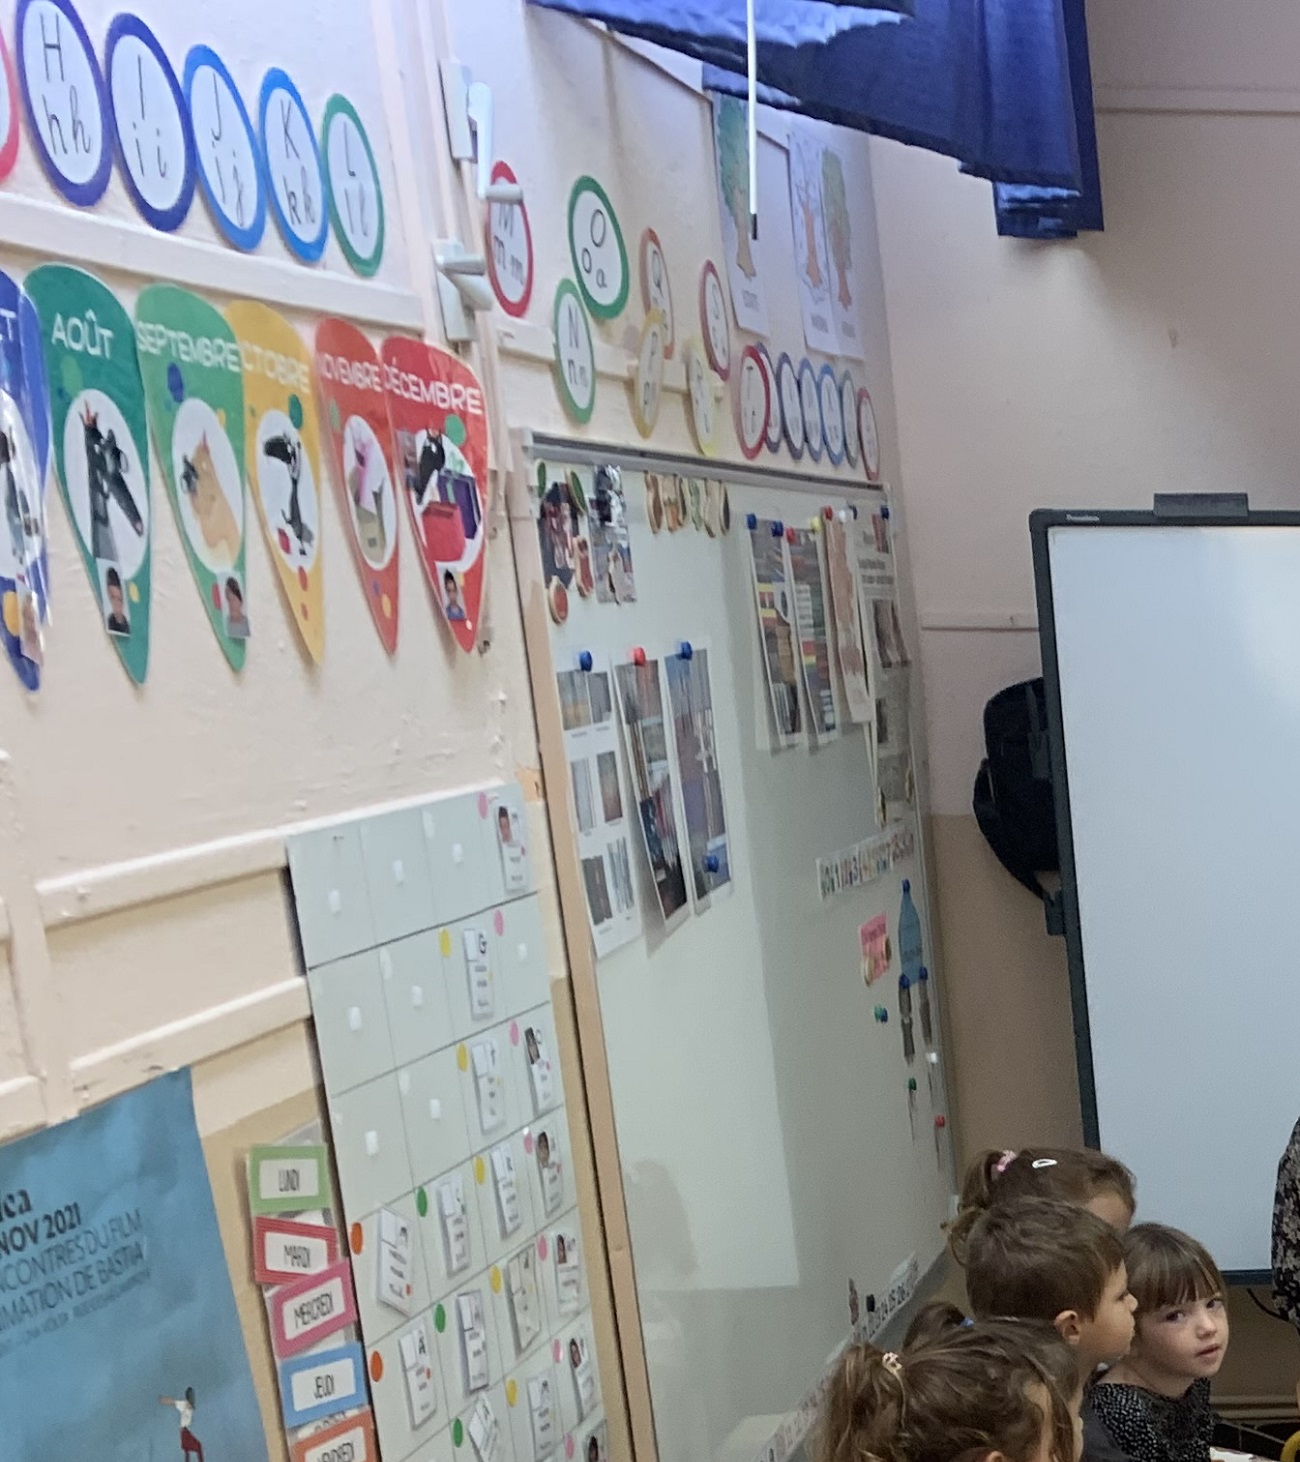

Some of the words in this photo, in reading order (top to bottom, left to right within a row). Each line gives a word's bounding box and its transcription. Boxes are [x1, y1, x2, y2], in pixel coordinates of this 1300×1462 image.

[40, 13, 65, 82] H
[279, 98, 300, 160] K
[51, 308, 114, 359] AOÛT
[137, 320, 241, 373] SEPTEMBRE
[242, 340, 311, 394] CTOBRE
[383, 356, 483, 416] DÉCEMBRE
[42, 1201, 82, 1240] 2021
[313, 1374, 336, 1400] JEUDI
